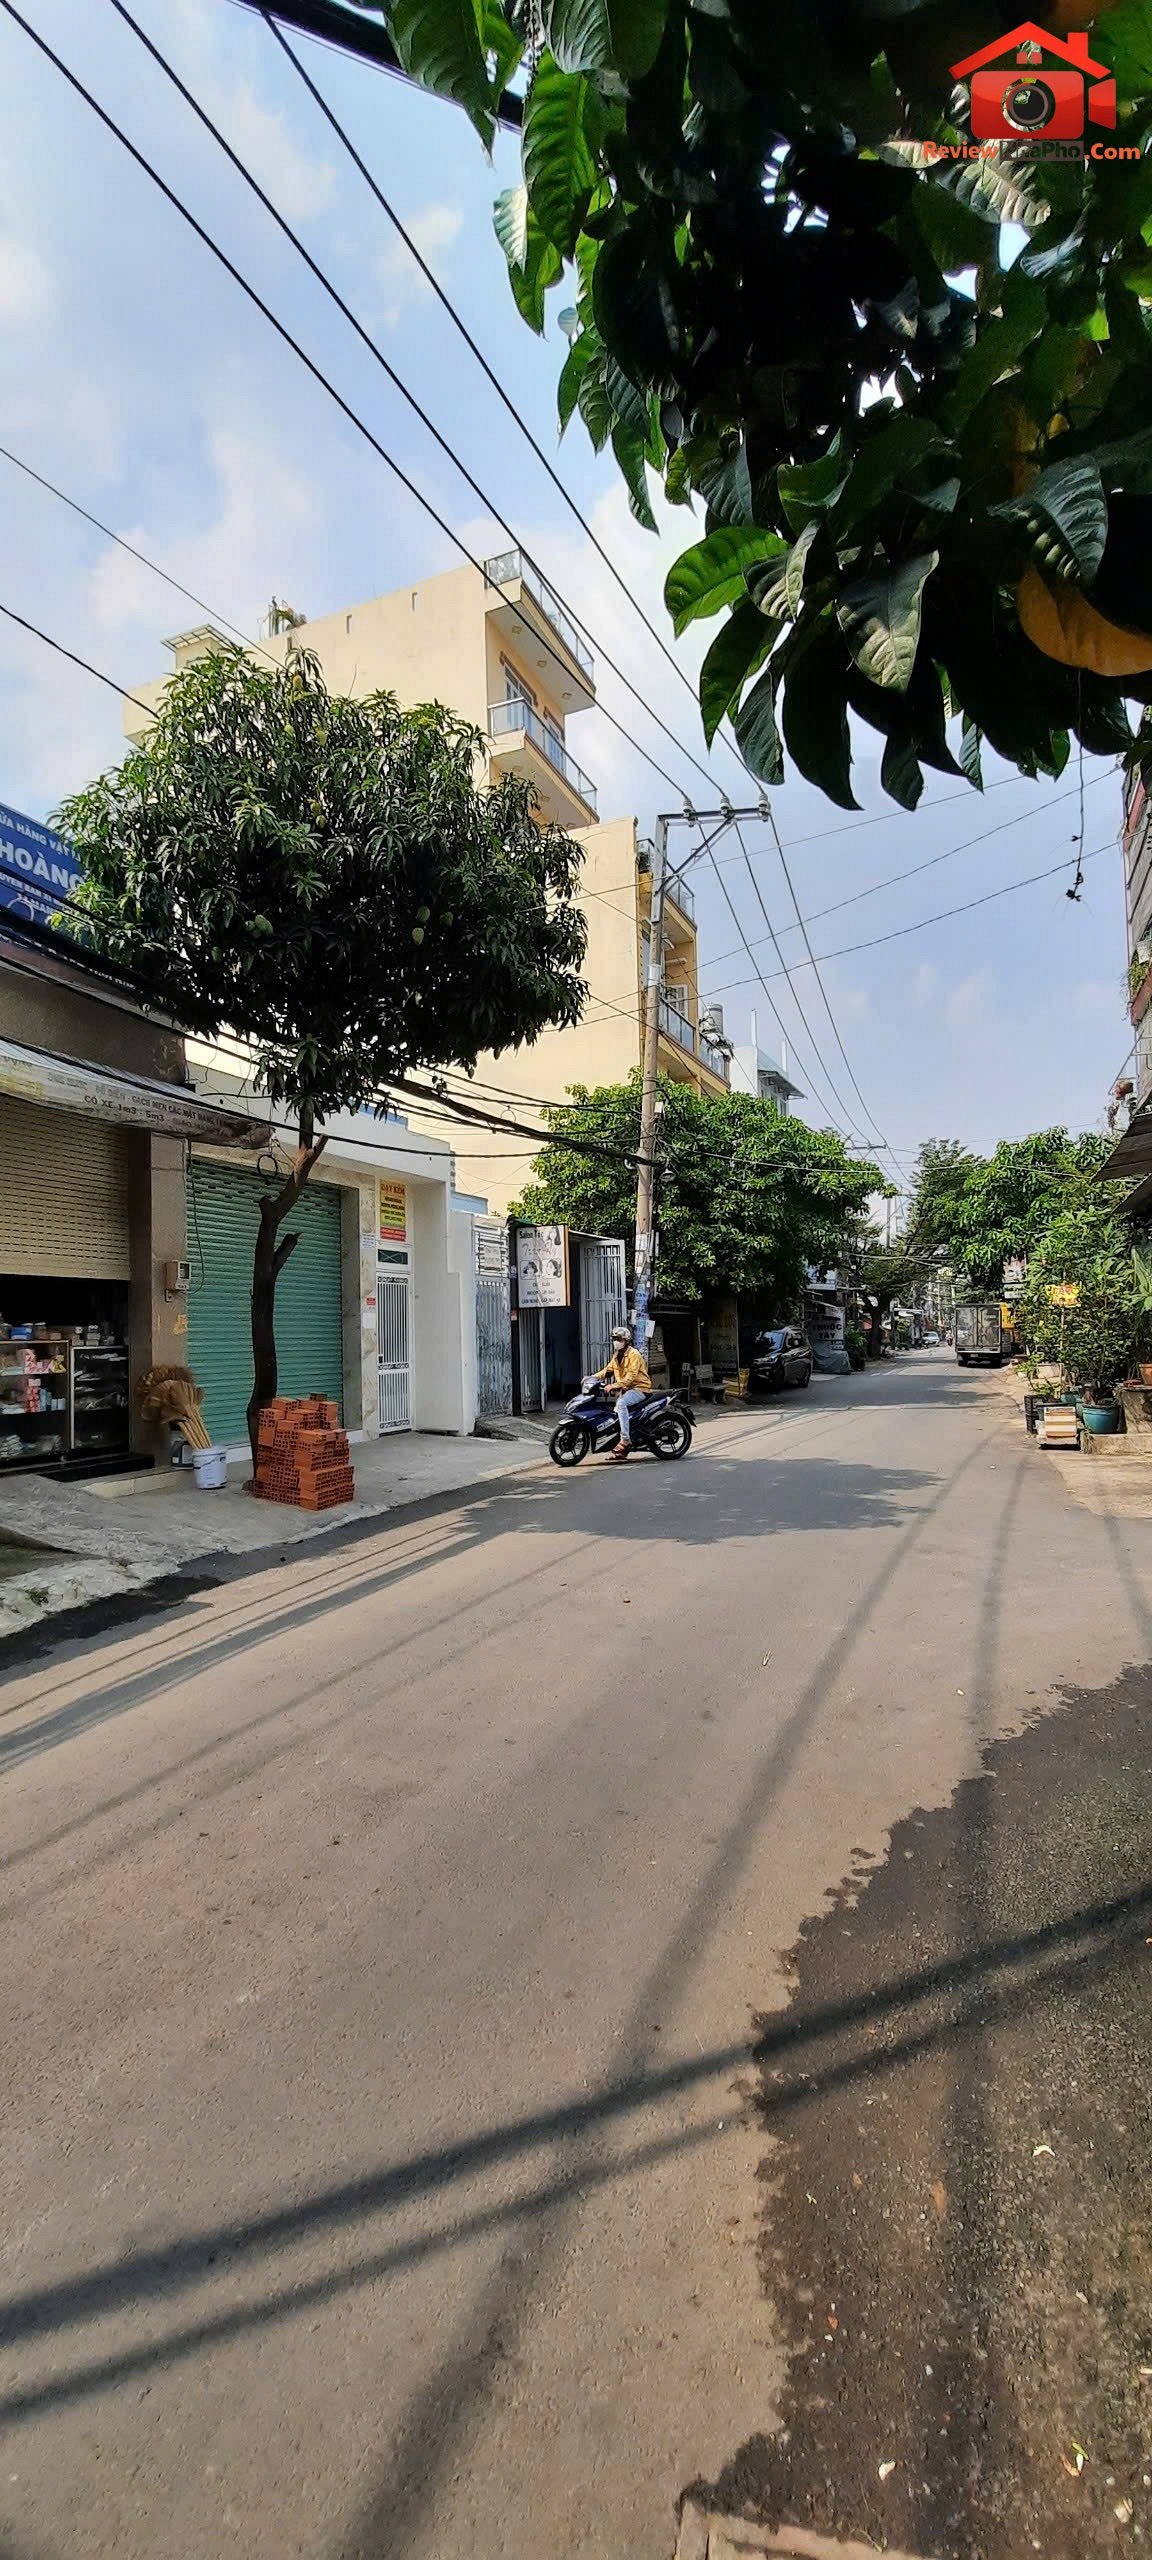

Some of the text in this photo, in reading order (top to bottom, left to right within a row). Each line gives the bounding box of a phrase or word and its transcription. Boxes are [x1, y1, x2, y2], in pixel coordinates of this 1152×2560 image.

[16, 822, 47, 846] HÀNG
[101, 1099, 114, 1109] XE
[118, 1104, 137, 1114] 1m3
[146, 1110, 165, 1121] 5m3
